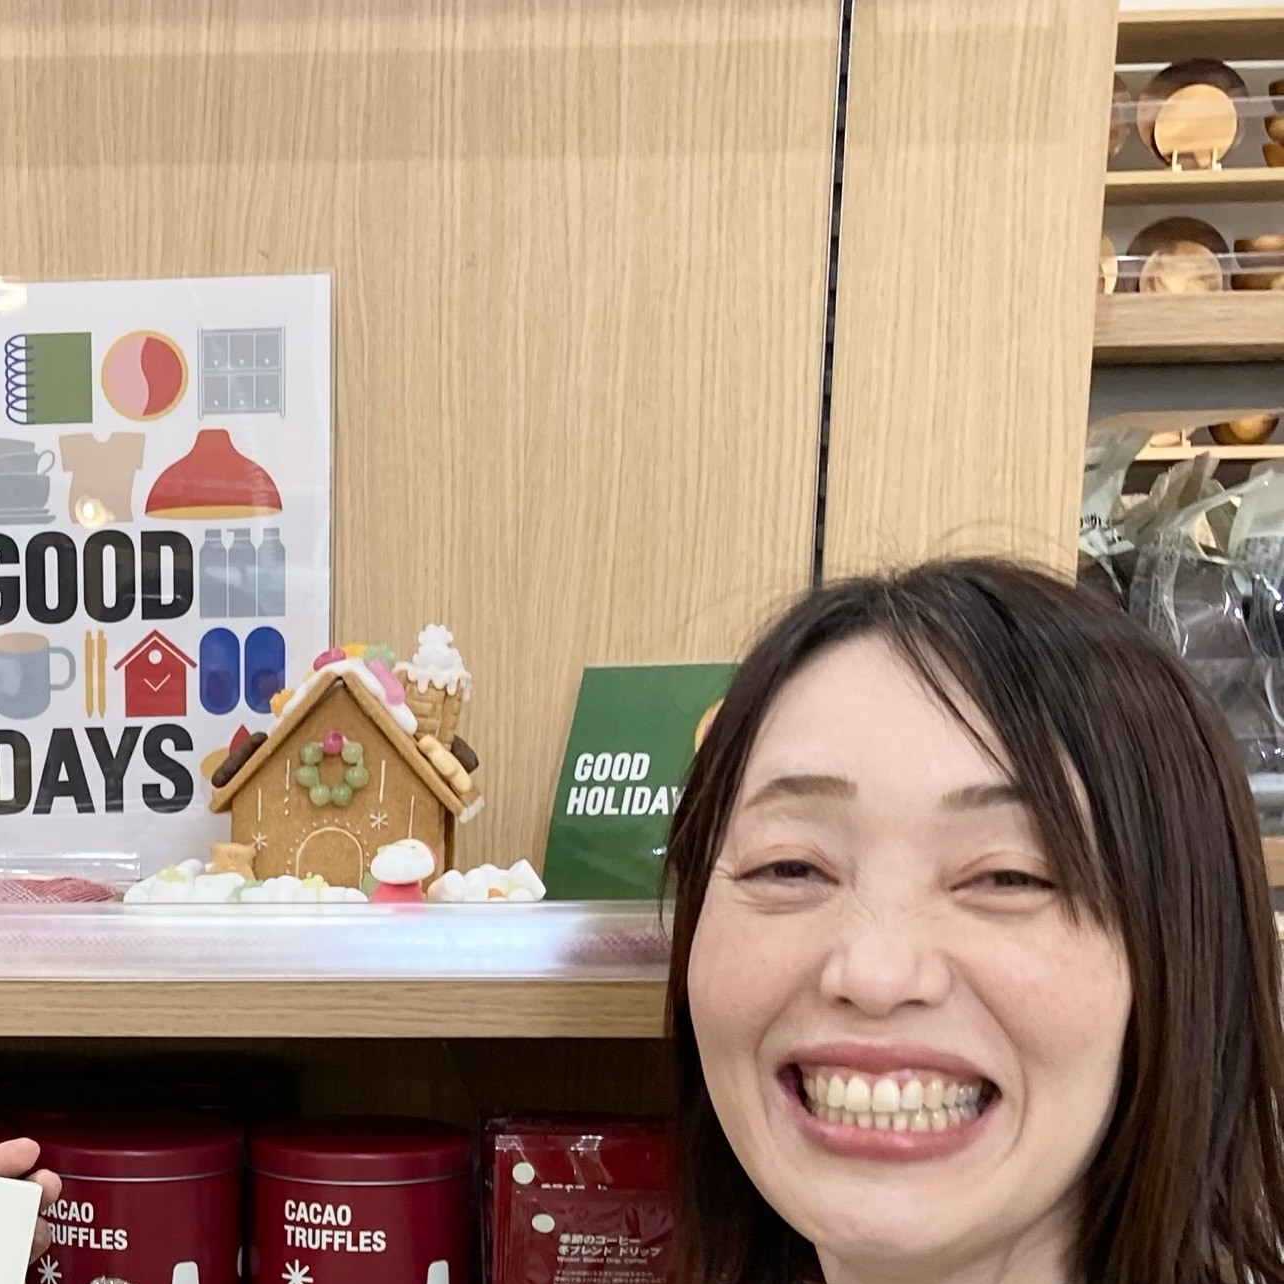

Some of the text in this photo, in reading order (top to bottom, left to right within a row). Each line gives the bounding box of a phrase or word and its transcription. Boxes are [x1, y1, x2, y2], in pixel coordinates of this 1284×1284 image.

[574, 752, 650, 781] GOOD
[566, 786, 686, 815] HOLIDAY
[284, 1199, 352, 1226] CACAO
[48, 1223, 128, 1250] RUFFLES
[284, 1224, 387, 1252] TRUFFLES
[559, 1233, 641, 1246] 季節のコーヒー
[558, 1246, 662, 1258] 冬ブレンド ドリップ
